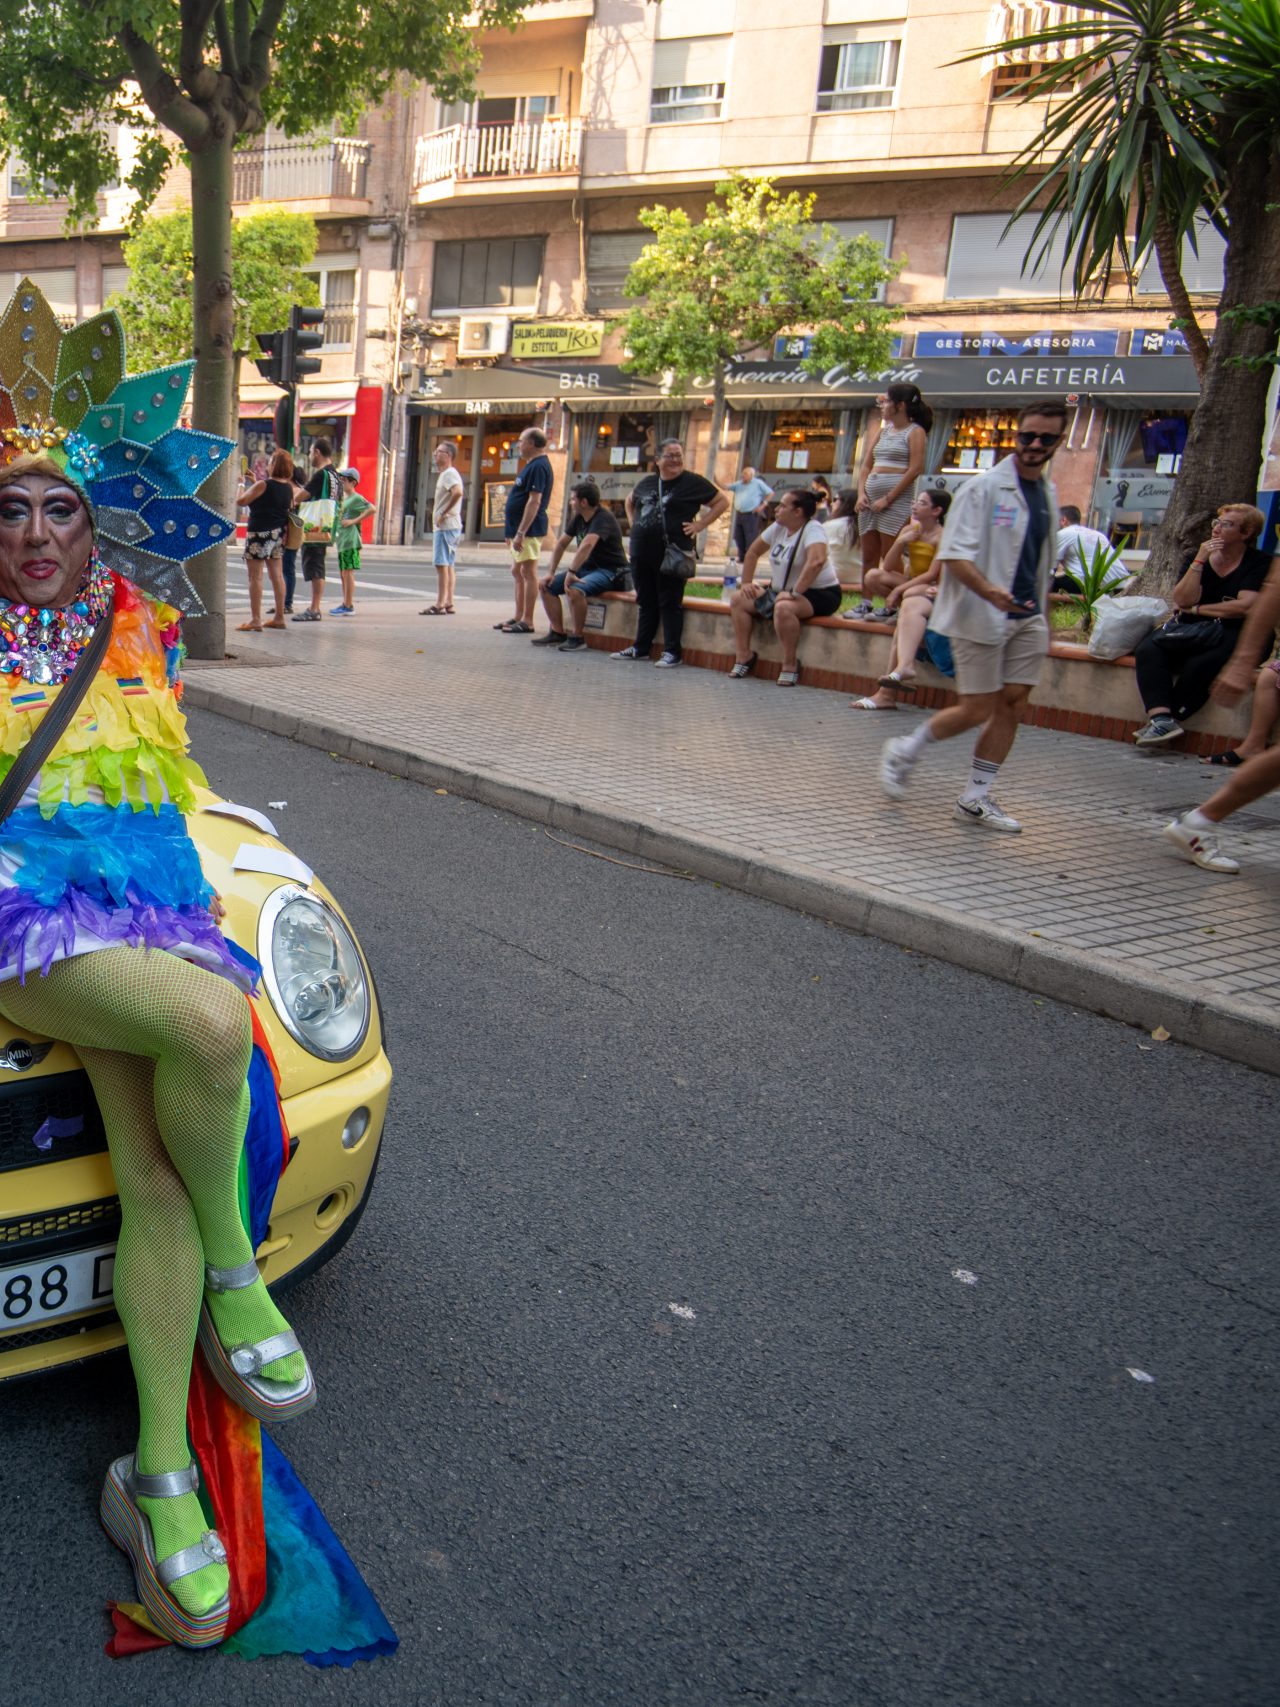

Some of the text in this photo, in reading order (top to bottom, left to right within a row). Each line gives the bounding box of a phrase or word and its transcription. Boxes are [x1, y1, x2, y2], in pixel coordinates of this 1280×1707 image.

[936, 338, 1005, 348] GESTORIA
[1023, 338, 1096, 348] ASESORIA
[560, 372, 600, 389] BAR
[986, 364, 1126, 385] CAFETERÍA
[466, 402, 490, 414] BAR
[8, 1049, 32, 1060] MINI
